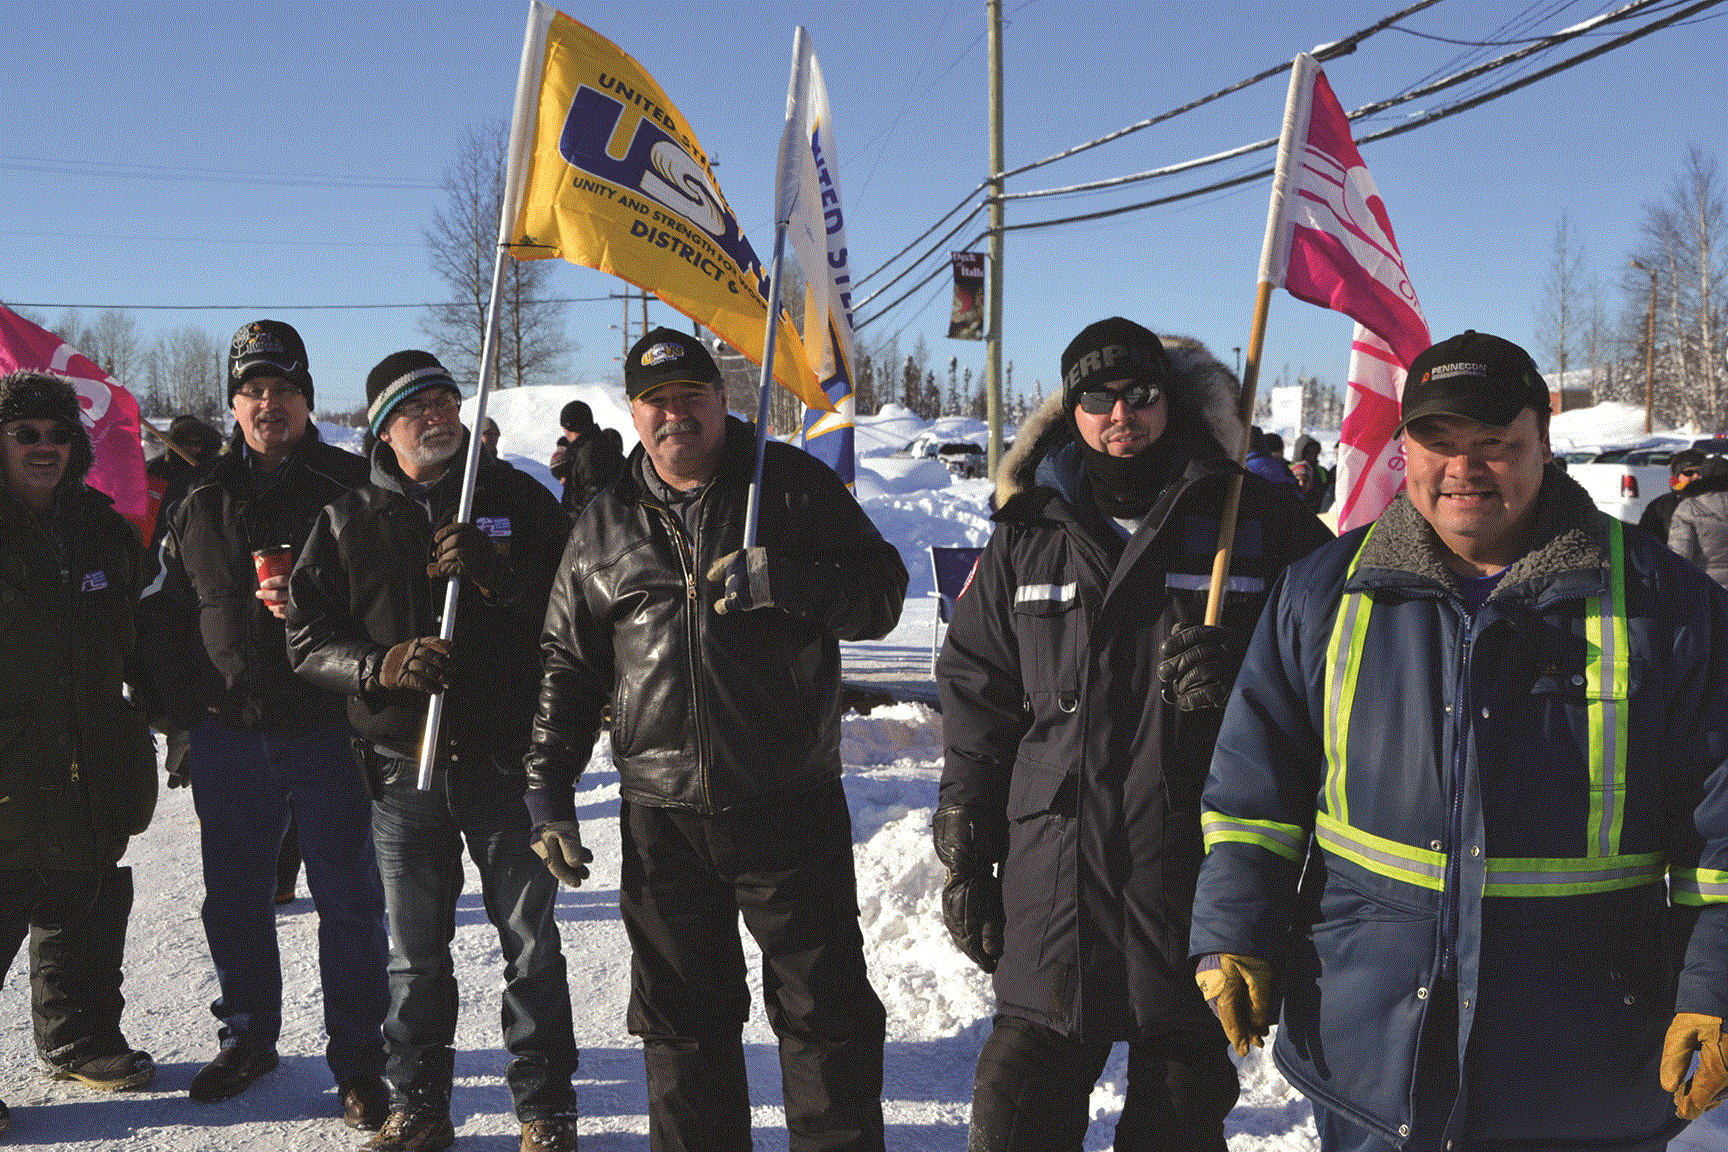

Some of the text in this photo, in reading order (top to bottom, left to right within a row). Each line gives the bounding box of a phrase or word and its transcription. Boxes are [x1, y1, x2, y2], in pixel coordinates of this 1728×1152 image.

[599, 73, 676, 131] UNITED
[572, 176, 617, 199] UNITY
[618, 194, 650, 215] AND
[652, 211, 716, 256] STRENGTH
[630, 219, 739, 294] DISTRICT 6
[1431, 362, 1487, 376] PENNECON
